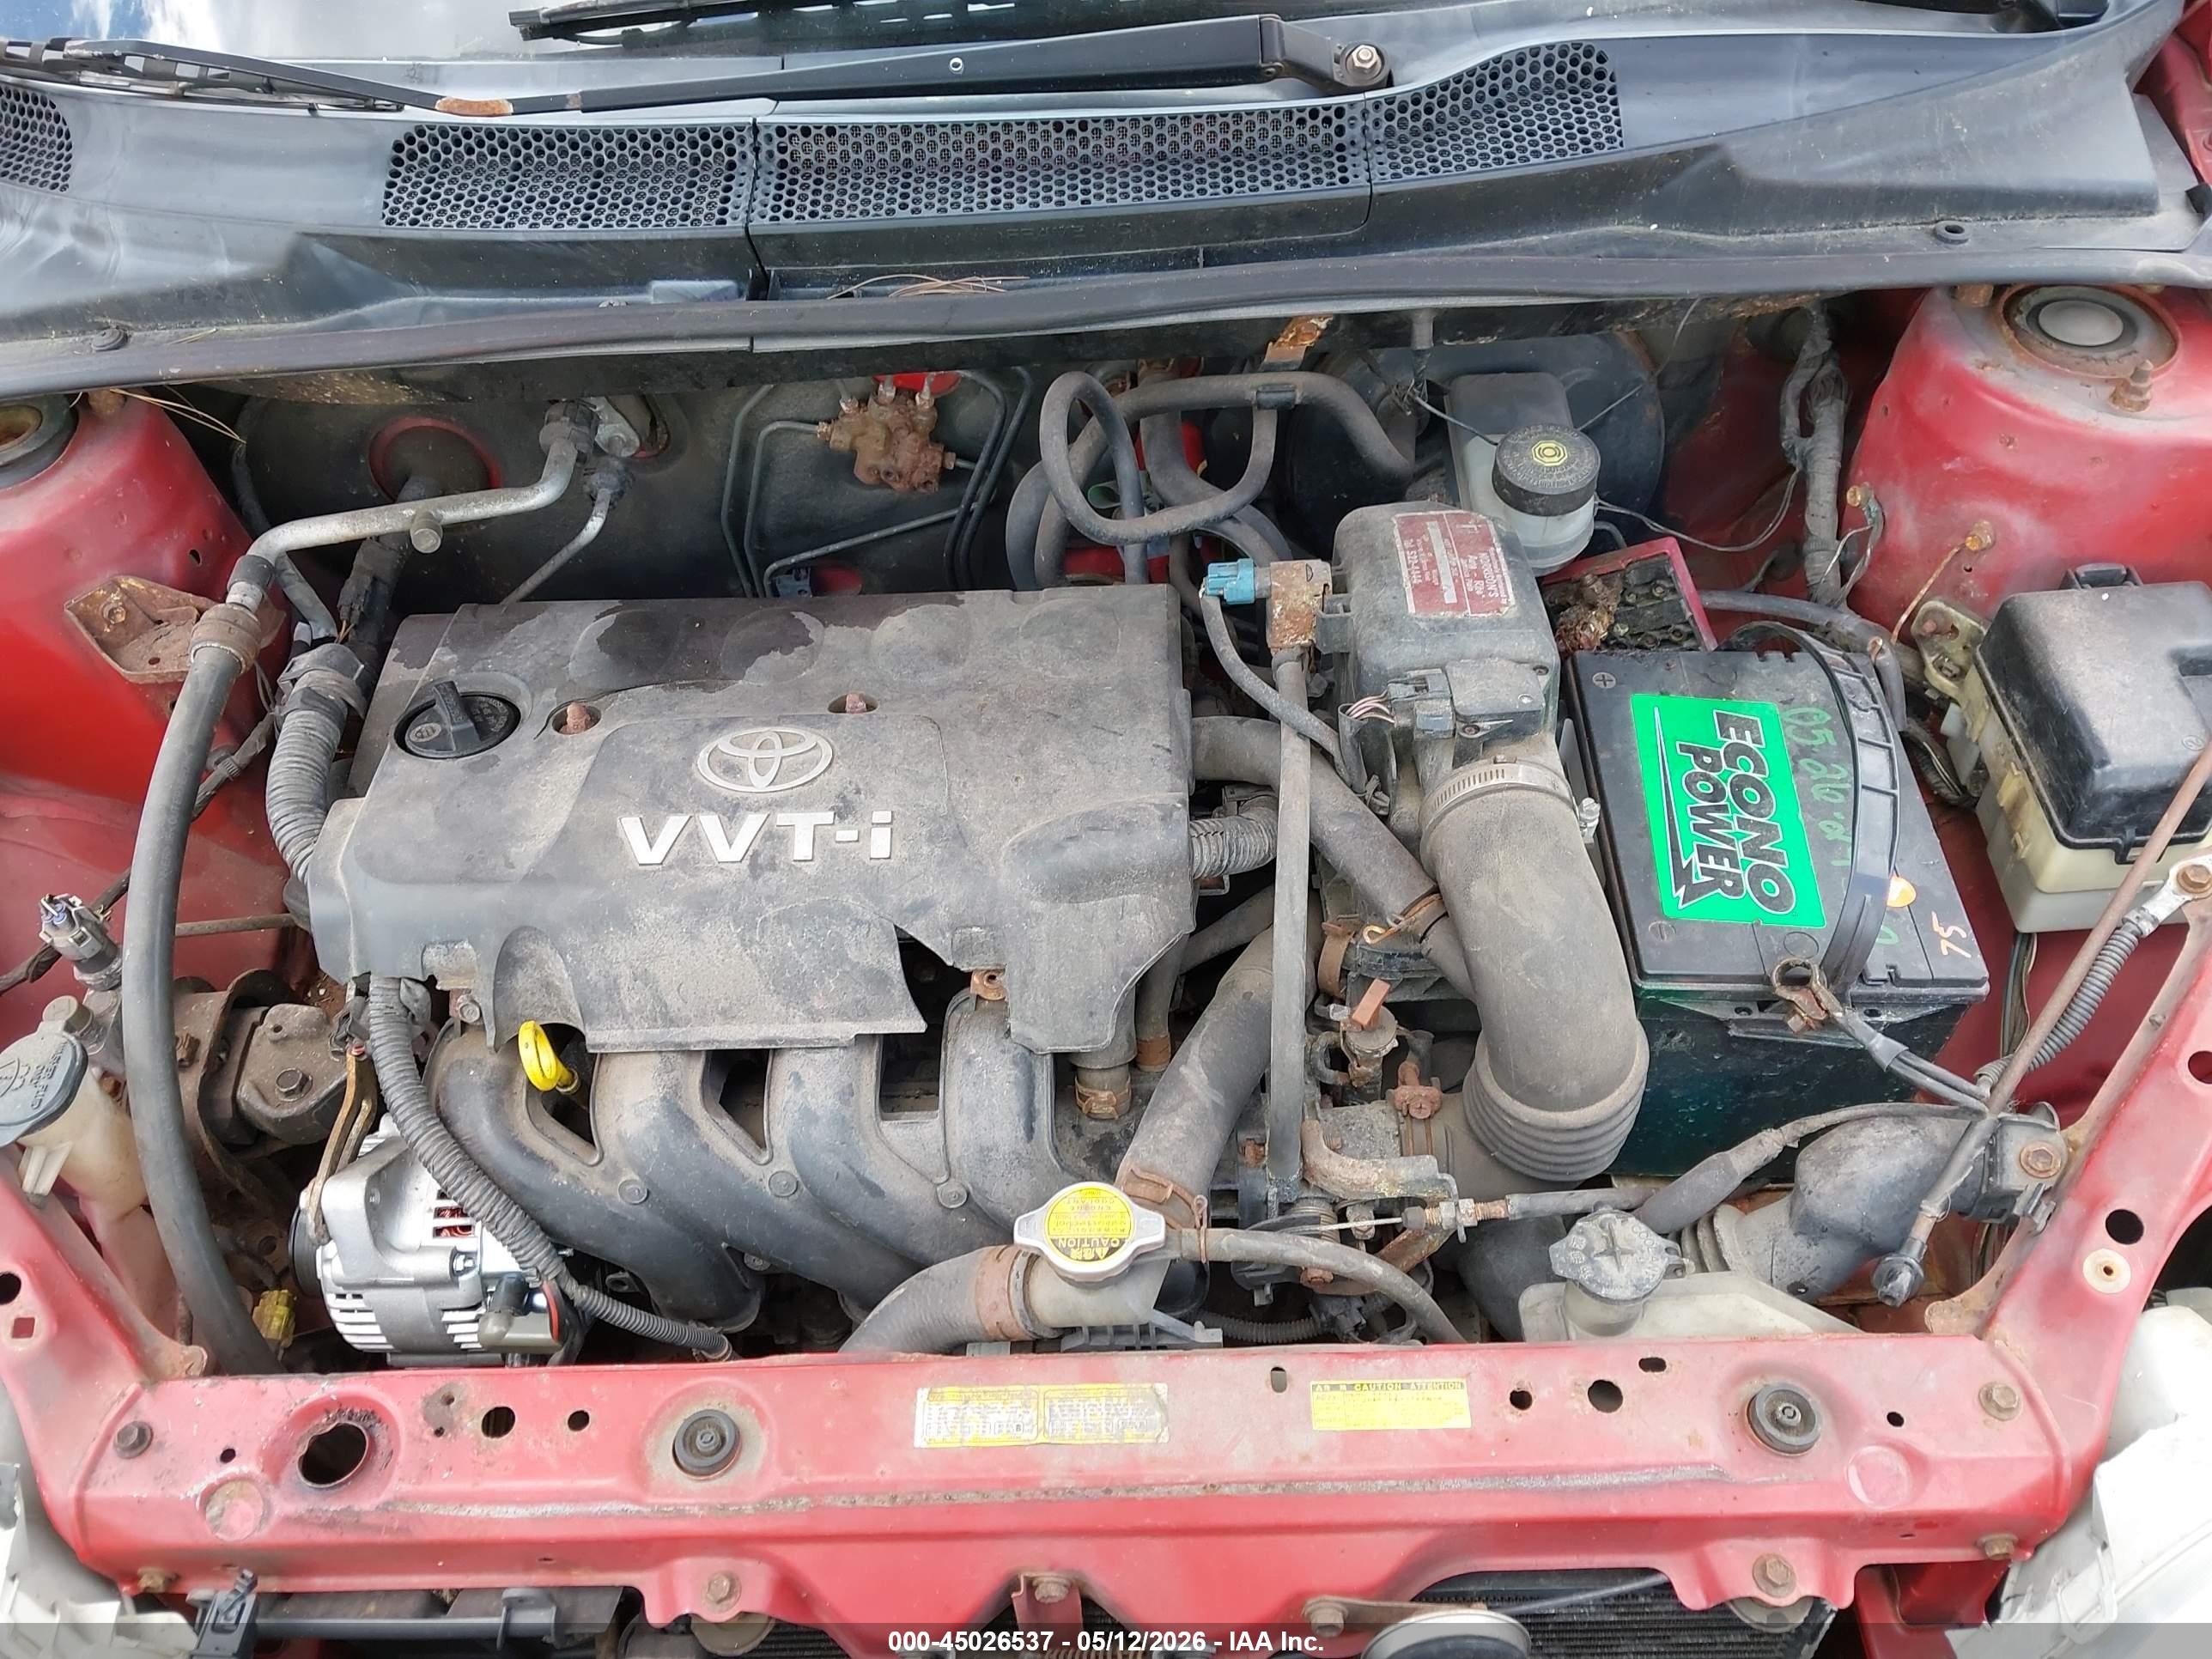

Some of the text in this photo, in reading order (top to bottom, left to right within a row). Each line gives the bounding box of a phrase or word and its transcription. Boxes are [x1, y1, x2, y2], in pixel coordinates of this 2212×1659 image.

[618, 810, 892, 866] VVT-i
[1676, 740, 1747, 900] POWER
[1713, 709, 1796, 915] ECONO
[1058, 1237, 1121, 1249] CAUTION
[1353, 1382, 1402, 1392] CAUTION
[1410, 1381, 1462, 1391] ATTENTION
